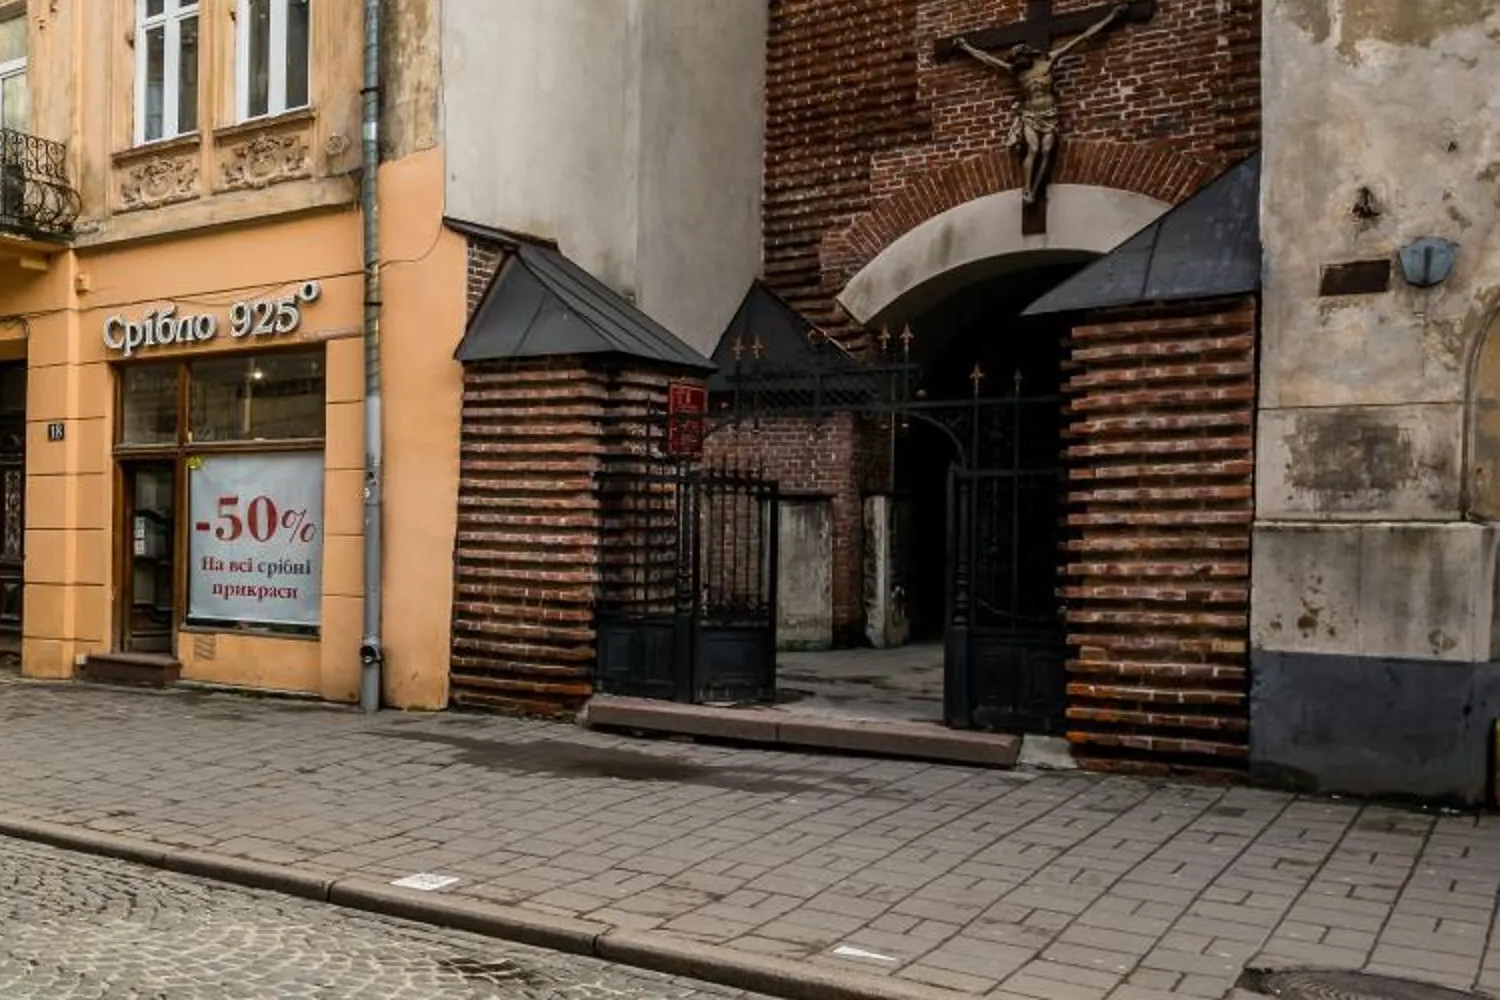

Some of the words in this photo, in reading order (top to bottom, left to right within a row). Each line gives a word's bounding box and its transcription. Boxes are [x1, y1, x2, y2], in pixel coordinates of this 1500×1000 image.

[102, 301, 218, 357] Срібло
[51, 423, 63, 441] 18
[195, 495, 317, 543] -50%
[201, 555, 225, 573] На
[229, 557, 253, 573] всі
[257, 559, 312, 578] срібні
[212, 583, 299, 602] прикраси
